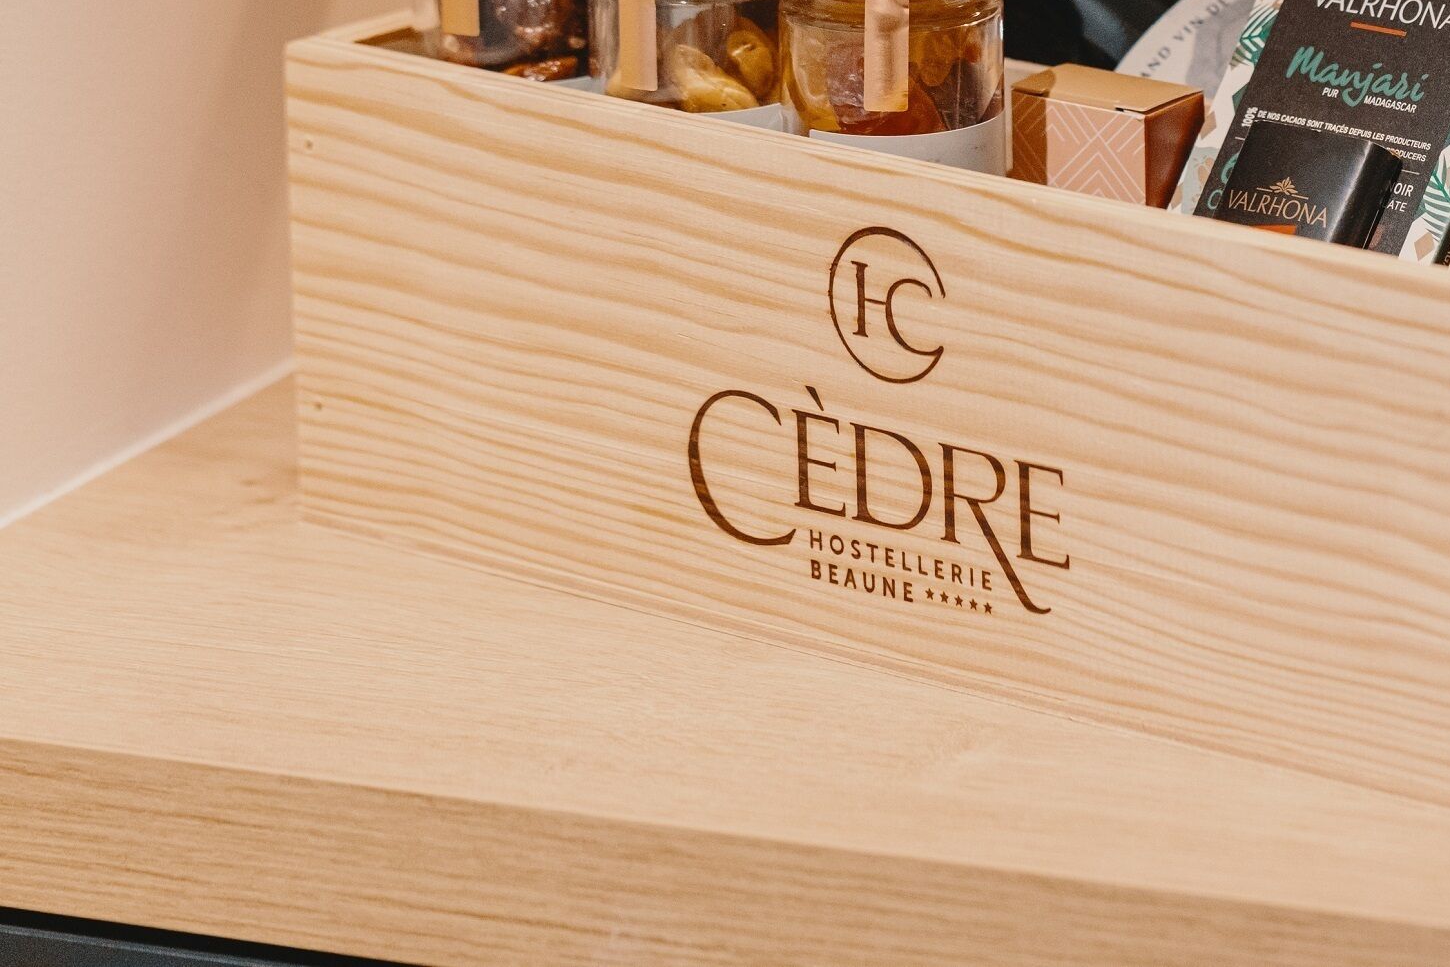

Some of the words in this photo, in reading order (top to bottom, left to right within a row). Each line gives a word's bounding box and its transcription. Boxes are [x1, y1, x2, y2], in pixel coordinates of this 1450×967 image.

[1140, 45, 1172, 78] AND
[1285, 45, 1430, 108] Manjari
[1241, 106, 1259, 128] 100%
[1321, 86, 1340, 99] PUR
[1363, 94, 1418, 114] MADAGASCAR
[1257, 109, 1268, 119] DE
[1267, 112, 1281, 122] NOS
[1280, 114, 1307, 126] CACAOS
[1306, 119, 1325, 129] SONT
[1348, 127, 1373, 139] DEPUIS
[1371, 132, 1385, 142] LES
[1384, 134, 1432, 151] PRODUCTEURS
[1387, 146, 1427, 162] ODUCERS
[1228, 189, 1329, 229] VALRHONA
[687, 385, 1071, 615] CÈDRE
[809, 529, 994, 592] HOSTELLERIE
[810, 559, 915, 604] BEAUNE
